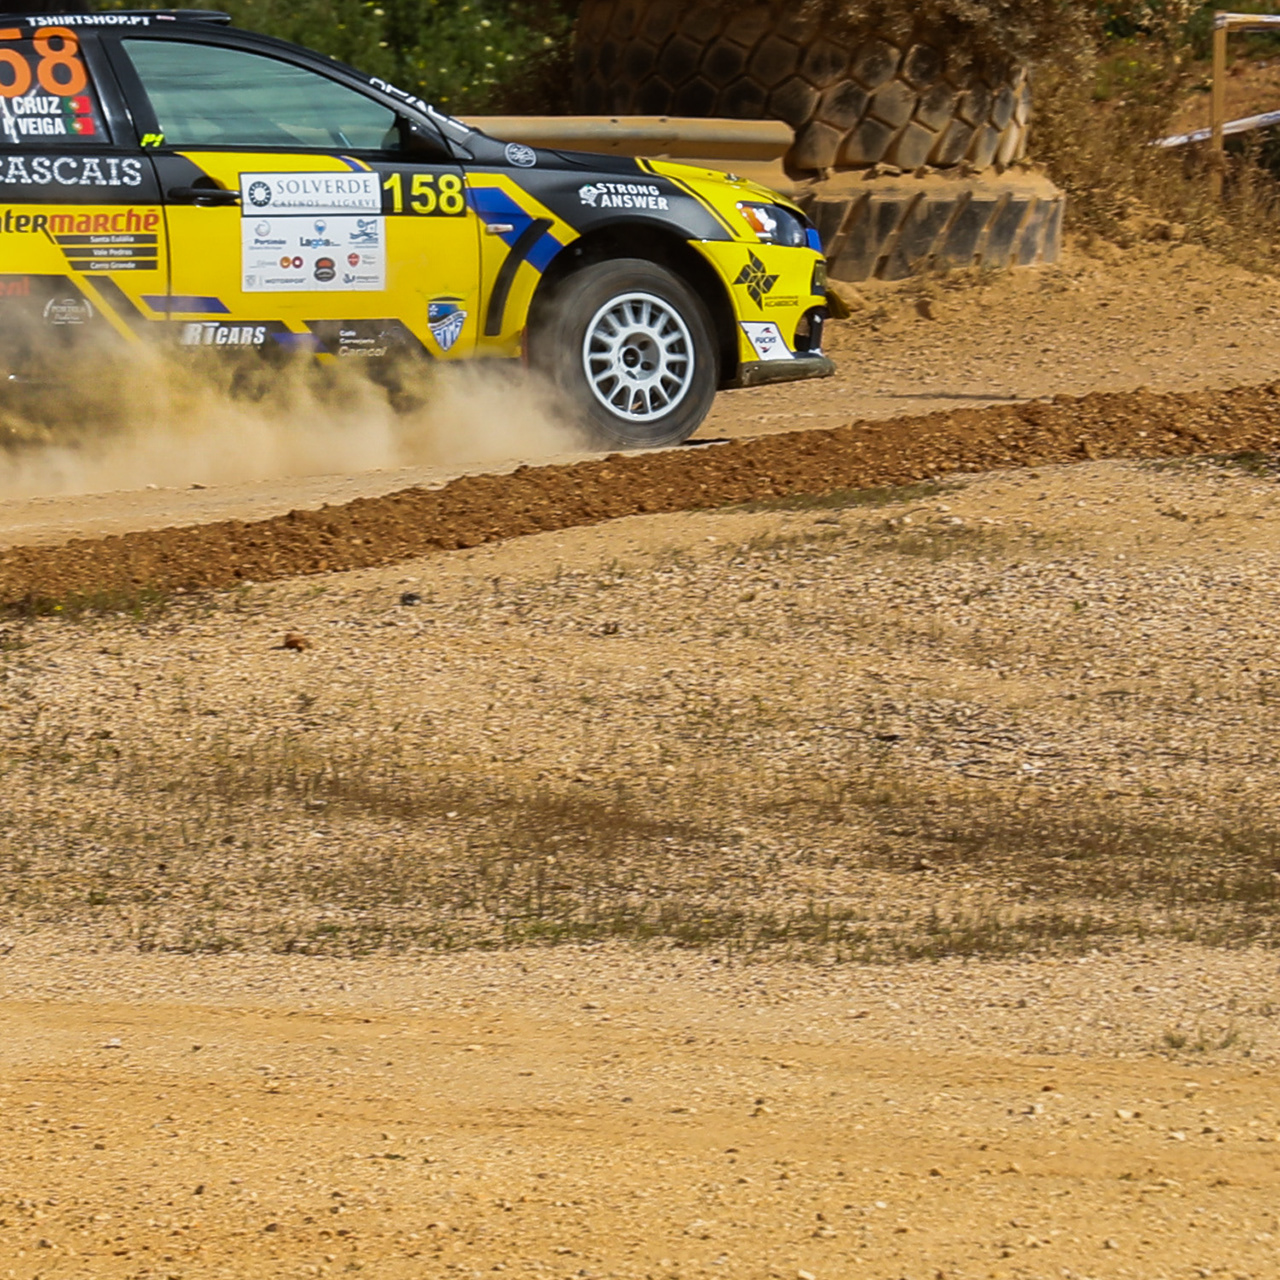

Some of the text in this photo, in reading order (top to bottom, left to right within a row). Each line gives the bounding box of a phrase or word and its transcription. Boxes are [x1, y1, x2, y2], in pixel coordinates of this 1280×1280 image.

[25, 14, 151, 27] TSHIRTSHOP.PT
[12, 96, 62, 114] CRUZ
[17, 117, 67, 135] VEIGA
[277, 179, 372, 194] SOLVERDE
[383, 172, 464, 214] 158
[596, 182, 660, 196] STRONG
[331, 199, 376, 208] ALGARVE
[601, 194, 669, 210] ANSWER
